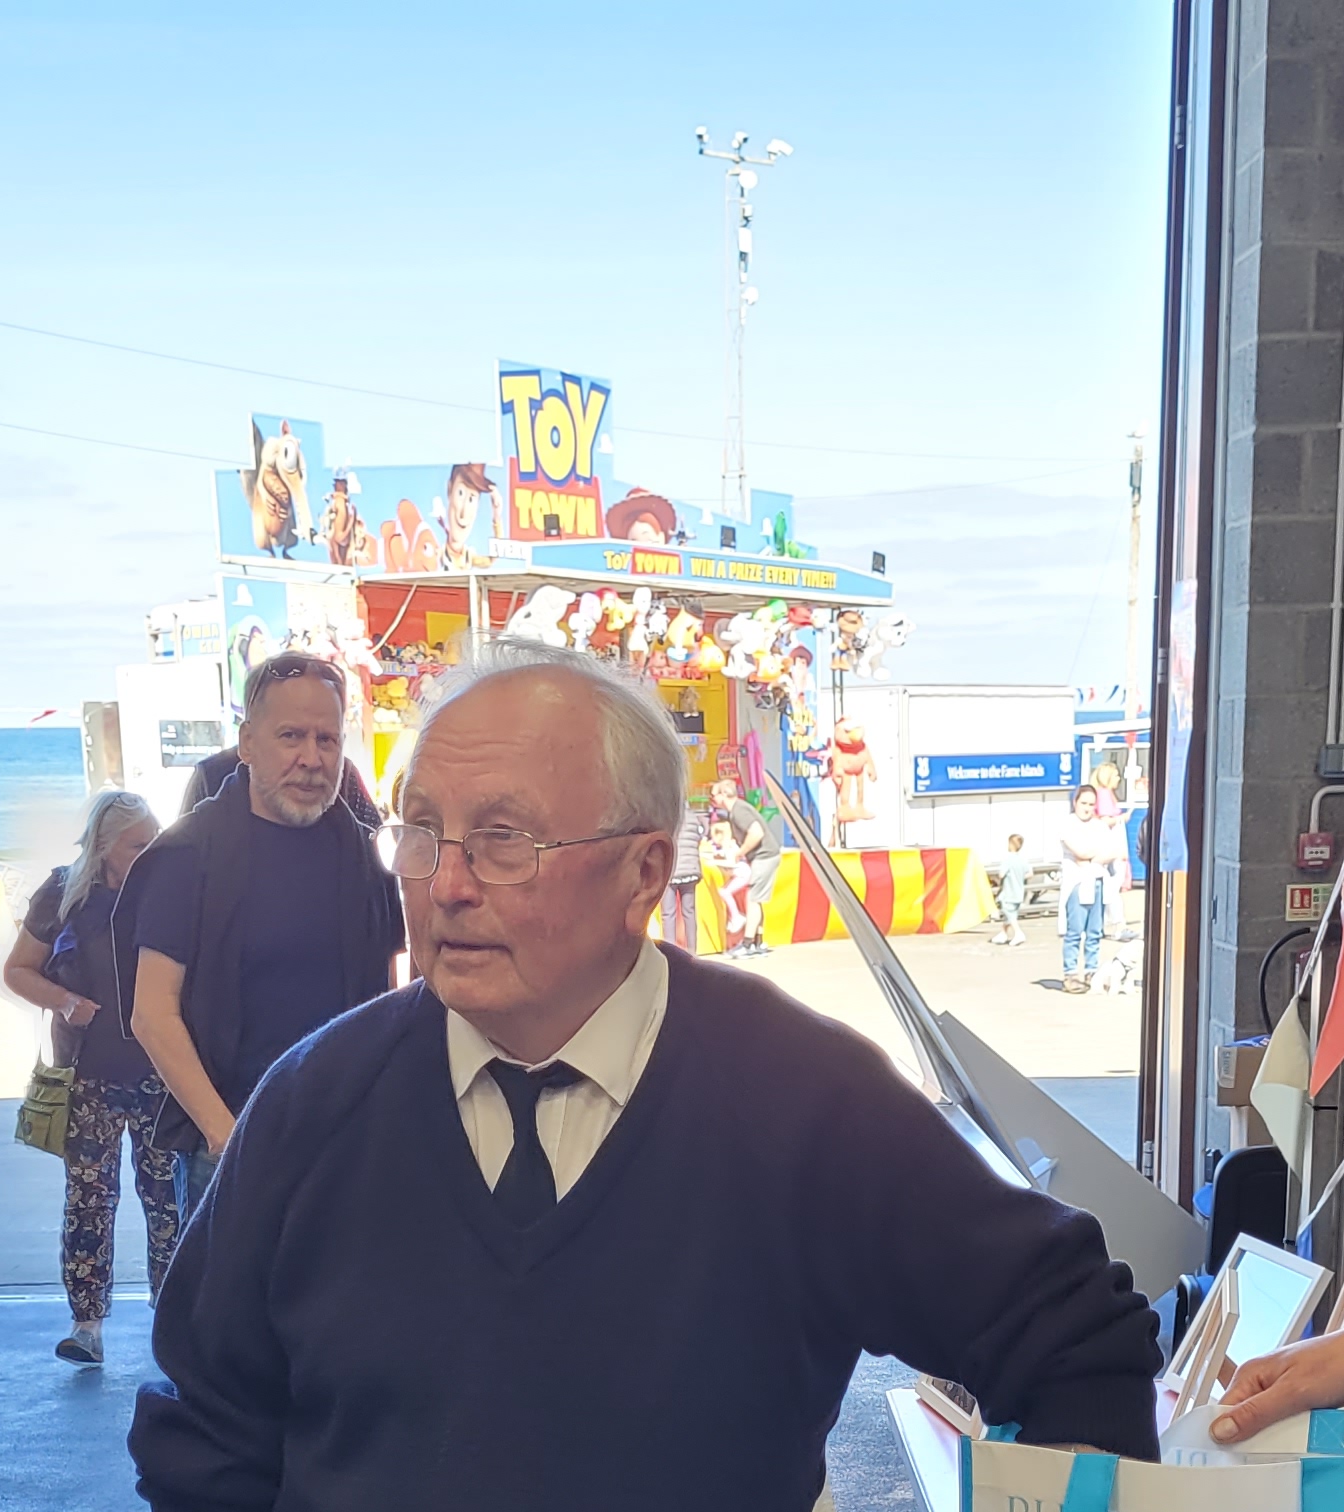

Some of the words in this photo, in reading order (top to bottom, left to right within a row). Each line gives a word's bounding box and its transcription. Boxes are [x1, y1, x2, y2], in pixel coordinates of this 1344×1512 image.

[500, 370, 610, 486] TOY
[514, 488, 596, 537] TOWN
[602, 550, 632, 571] TOY
[635, 552, 680, 575] TOWN
[690, 557, 715, 578] WIN
[716, 560, 727, 579] A
[728, 561, 764, 583] PRIZE
[765, 565, 801, 587] EVERY
